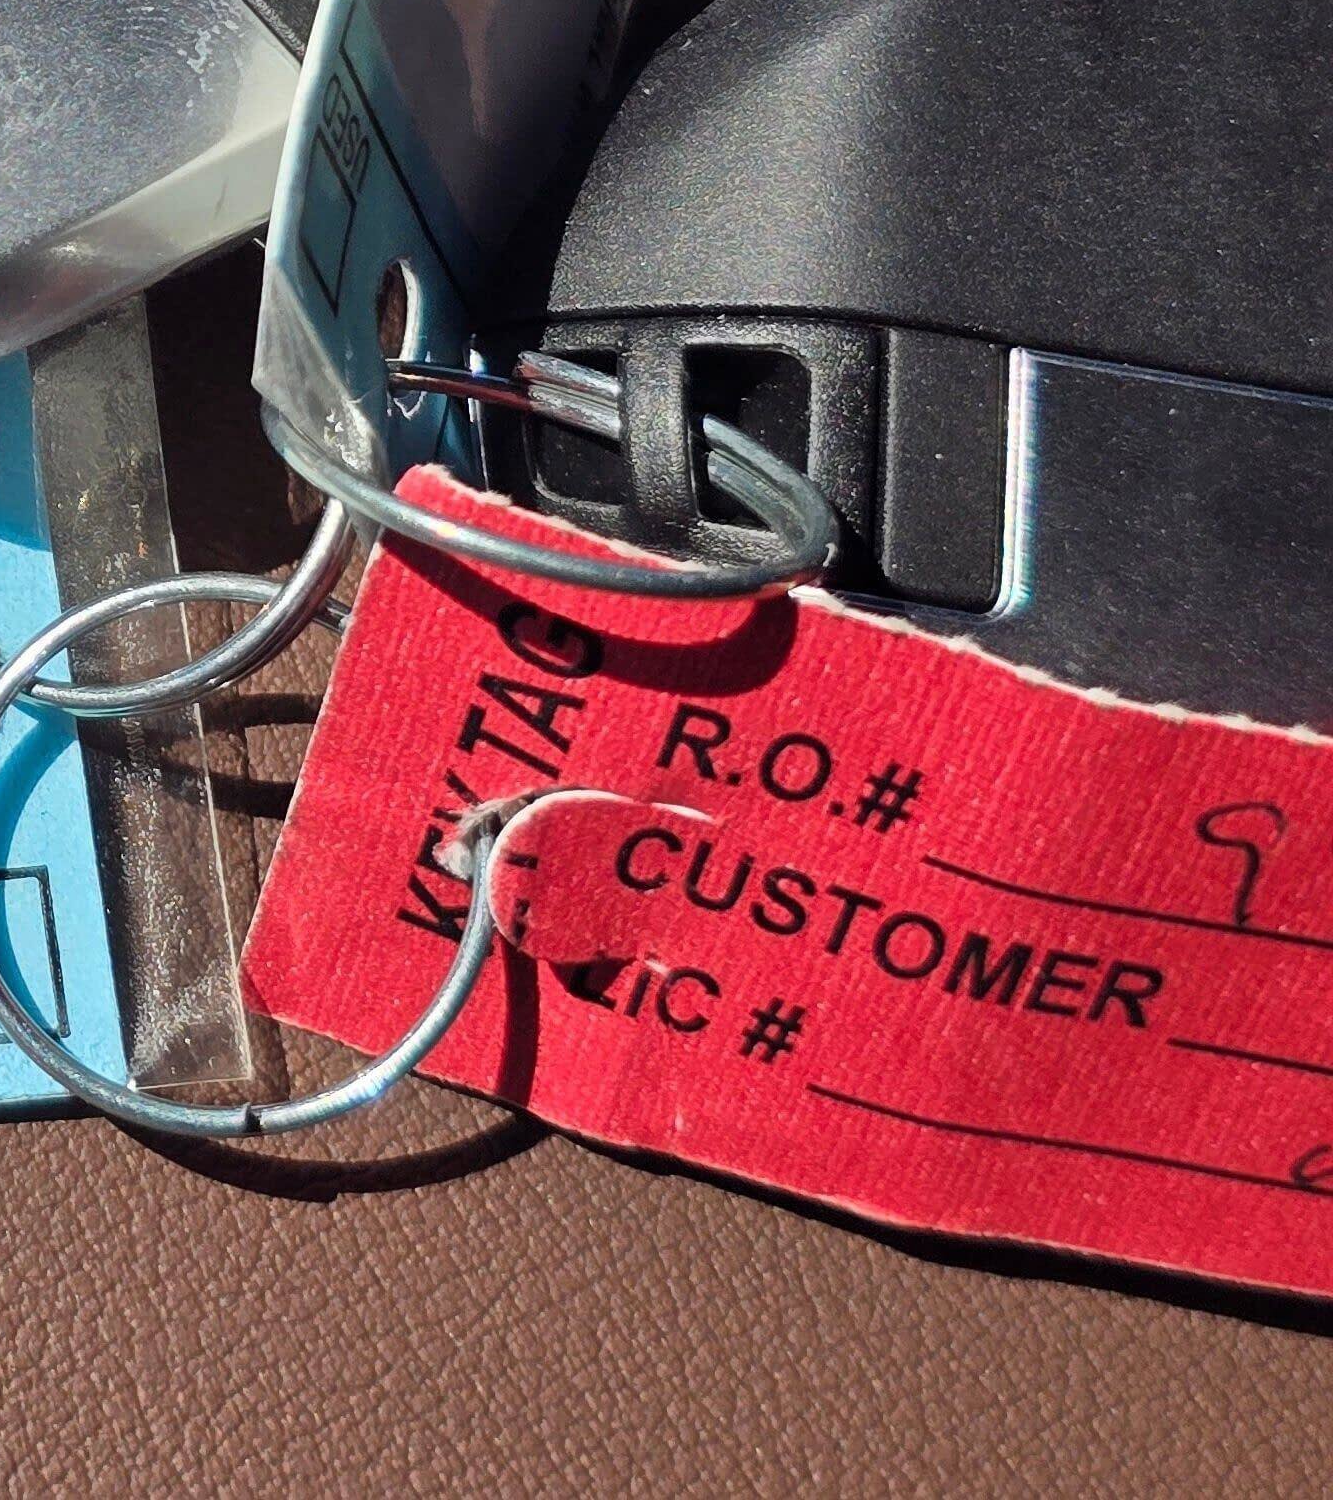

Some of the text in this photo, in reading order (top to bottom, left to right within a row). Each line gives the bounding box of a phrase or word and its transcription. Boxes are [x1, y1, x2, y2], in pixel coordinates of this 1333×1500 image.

[321, 75, 370, 192] USED
[456, 602, 605, 780] TAG
[614, 827, 1164, 1028] CUSTOMER
[738, 997, 807, 1065] #
